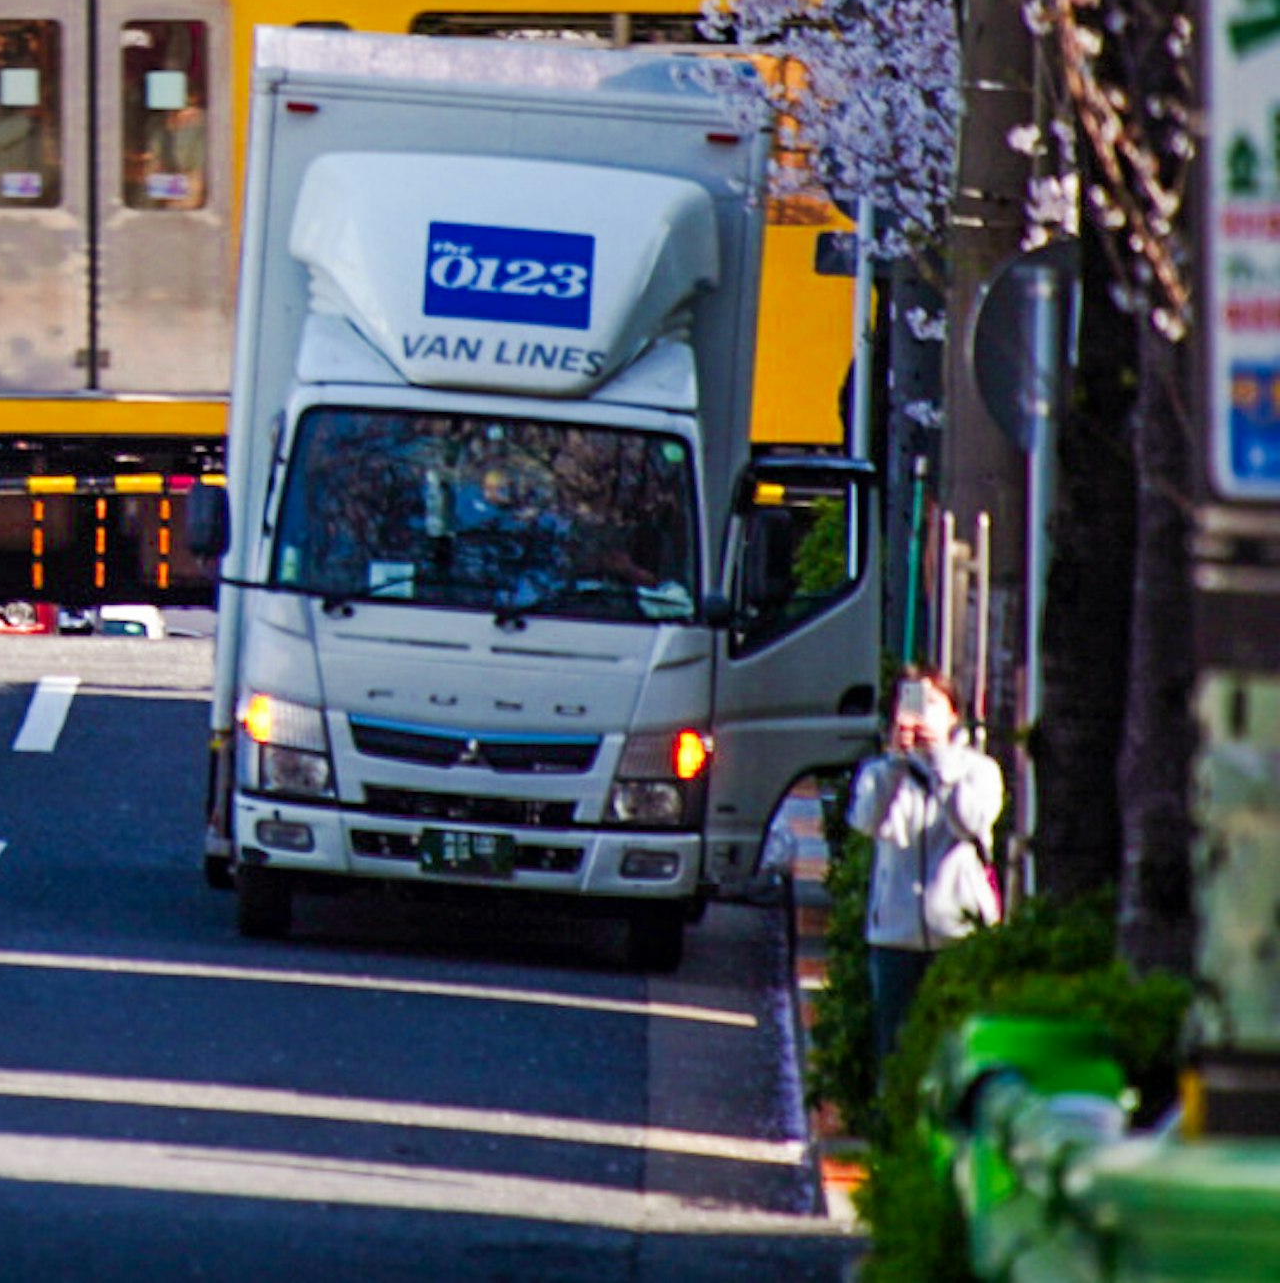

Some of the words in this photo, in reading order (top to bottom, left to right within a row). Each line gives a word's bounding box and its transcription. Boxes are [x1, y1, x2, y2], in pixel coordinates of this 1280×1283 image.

[430, 255, 587, 298] 0123
[403, 334, 482, 362] VAN
[495, 340, 606, 377] LINES
